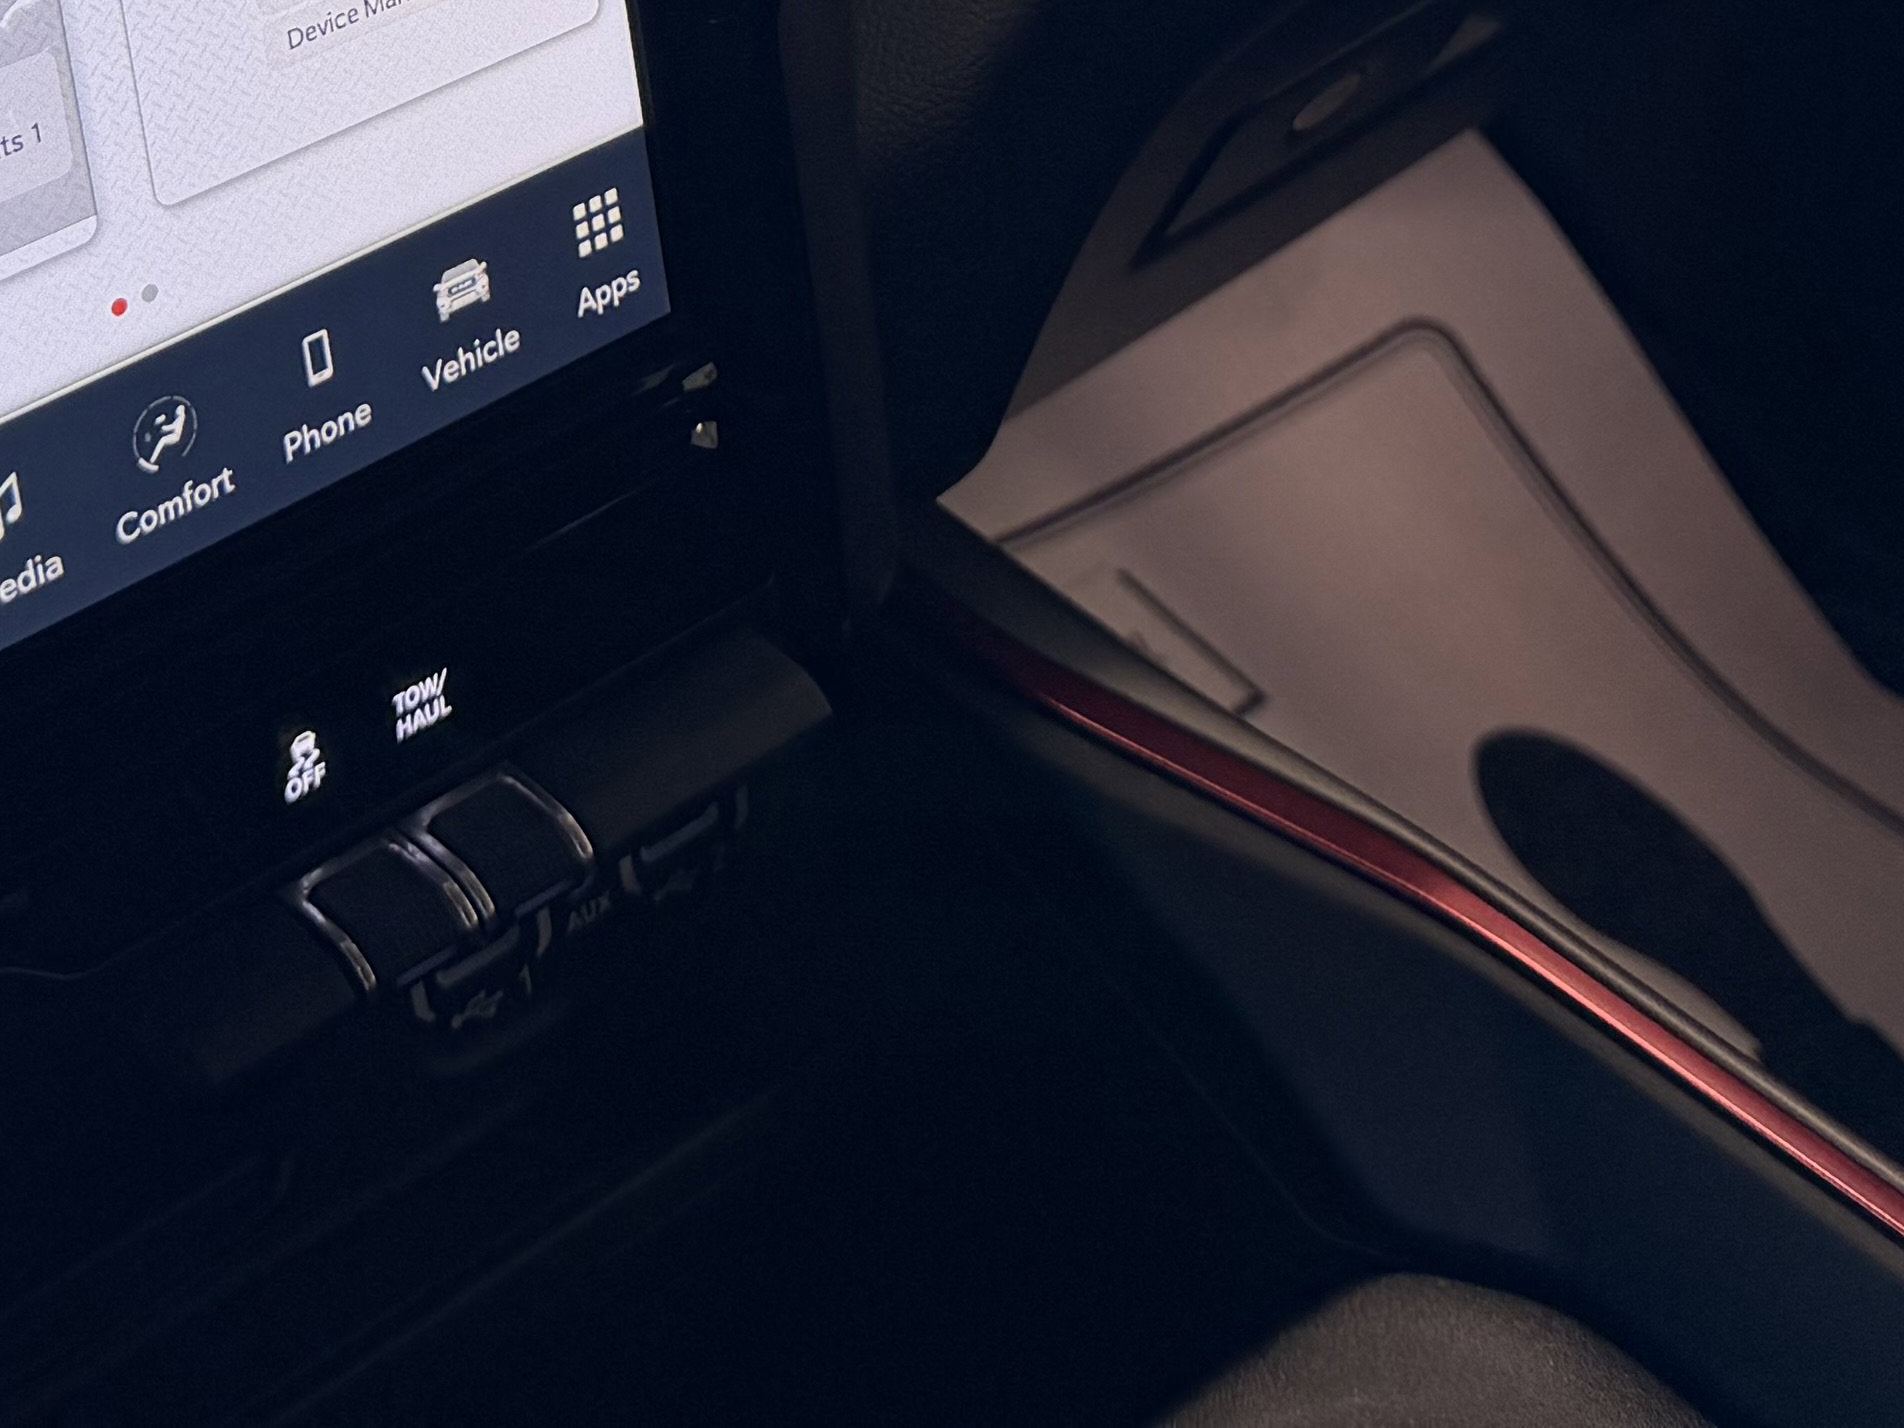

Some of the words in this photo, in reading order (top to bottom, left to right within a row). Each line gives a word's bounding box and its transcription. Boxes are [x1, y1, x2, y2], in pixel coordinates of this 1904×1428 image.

[287, 3, 360, 51] Device
[30, 123, 44, 144] 1
[576, 267, 641, 318] Apps
[421, 325, 521, 393] Vehicle
[282, 402, 373, 465] Phone
[115, 467, 236, 546] Comfort
[393, 666, 448, 715] TOW/
[396, 696, 453, 744] HAUL
[284, 762, 326, 804] OFF
